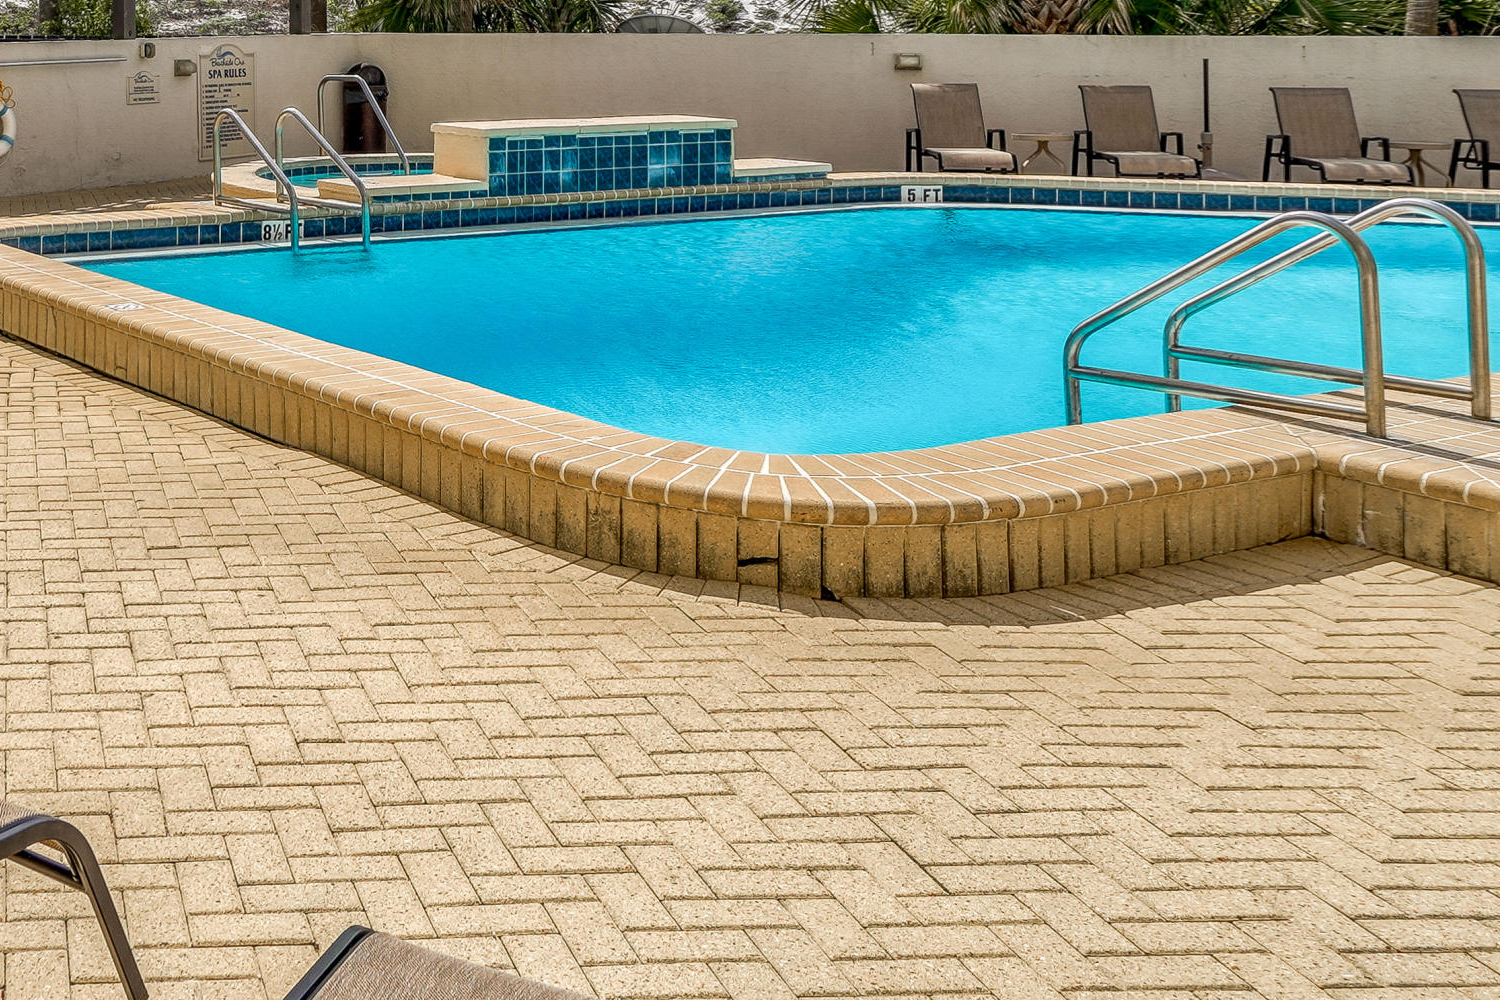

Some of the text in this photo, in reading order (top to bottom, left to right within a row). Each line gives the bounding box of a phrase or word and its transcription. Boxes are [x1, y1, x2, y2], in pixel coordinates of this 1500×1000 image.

[208, 68, 247, 79] SPA RULES
[907, 188, 916, 202] 5
